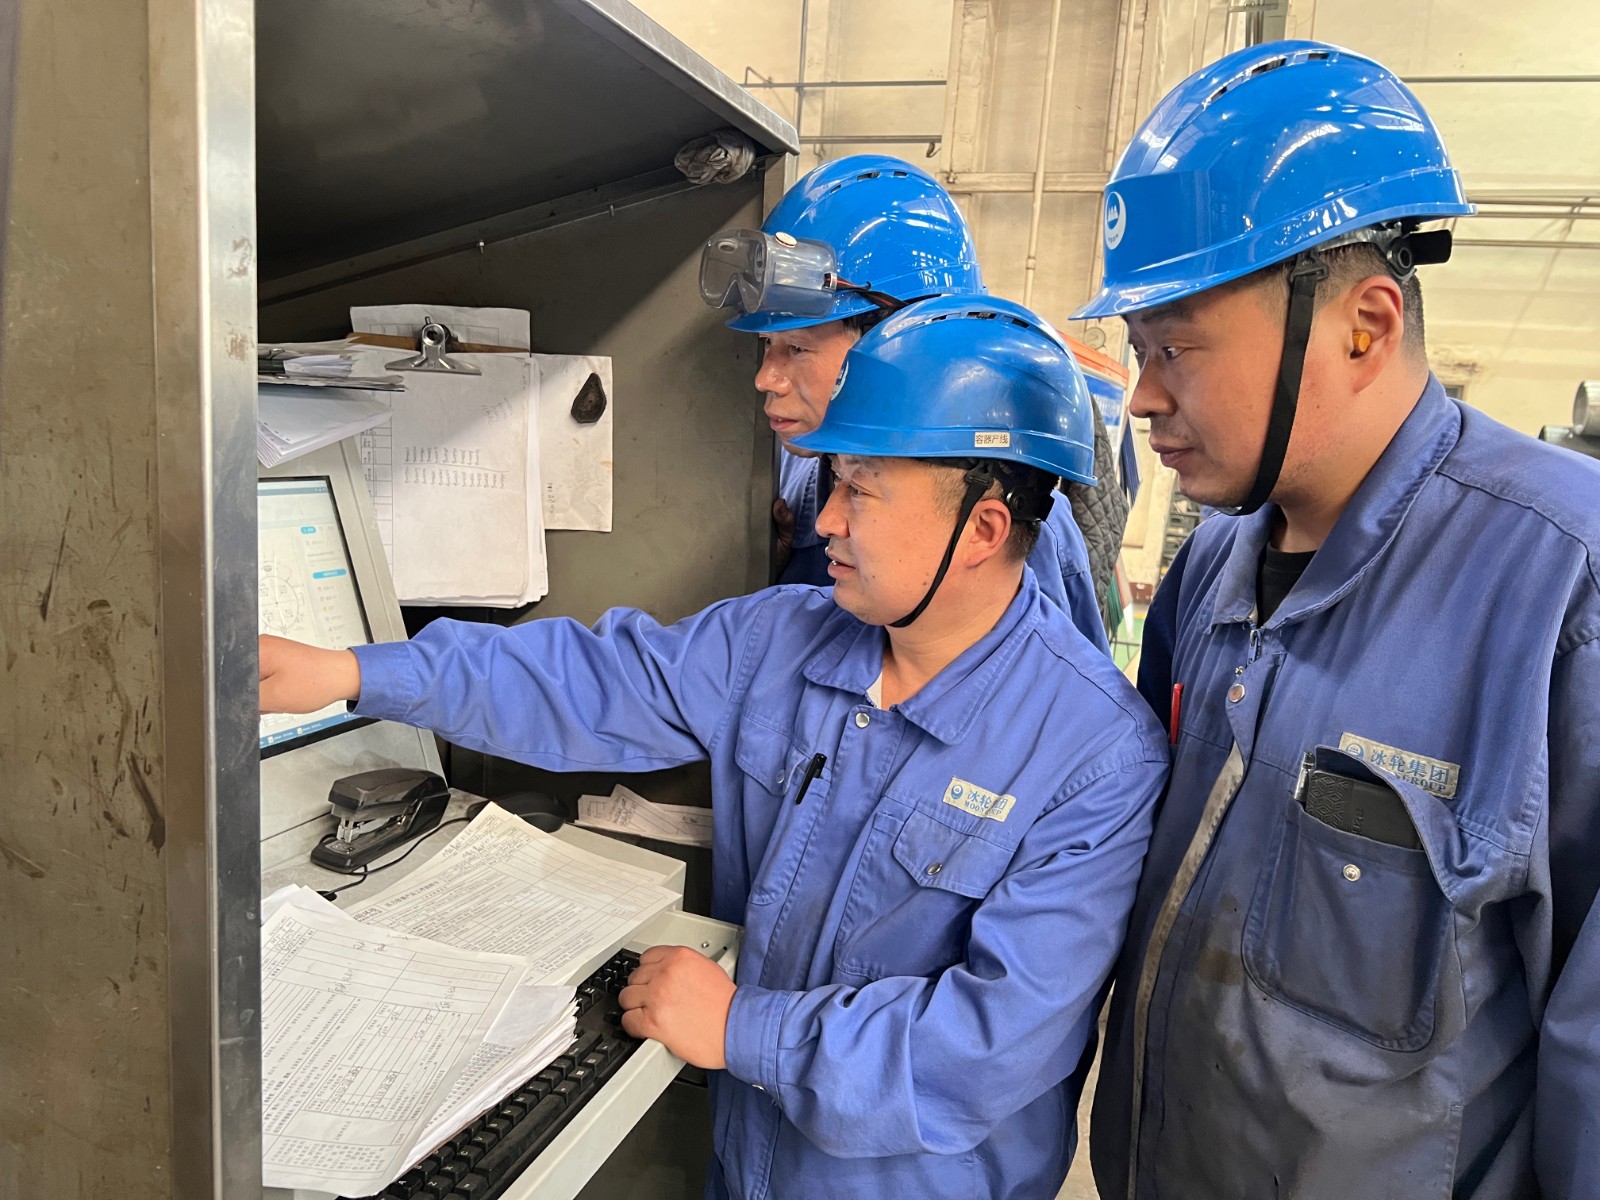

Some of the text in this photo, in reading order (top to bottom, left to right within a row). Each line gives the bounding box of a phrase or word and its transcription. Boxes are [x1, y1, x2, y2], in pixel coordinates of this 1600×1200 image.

[975, 434, 1008, 445] 容器产线
[1370, 749, 1450, 784] 冰轮集团
[967, 790, 1008, 810] 冰轮团
